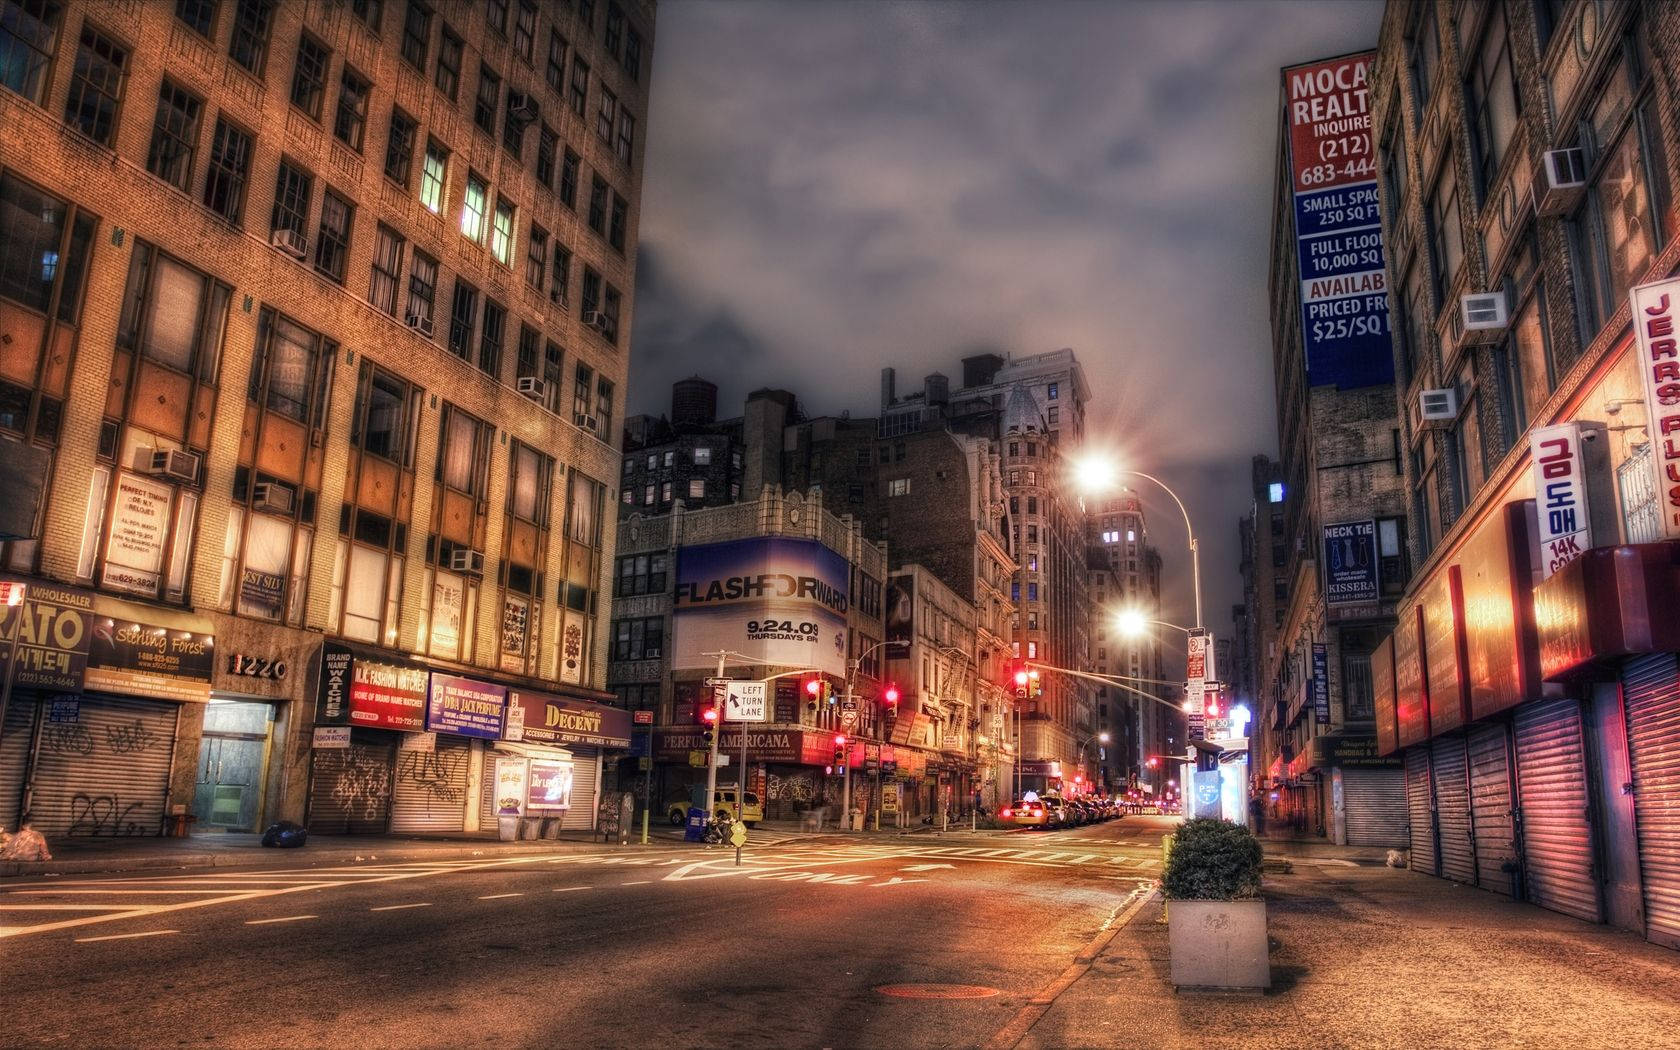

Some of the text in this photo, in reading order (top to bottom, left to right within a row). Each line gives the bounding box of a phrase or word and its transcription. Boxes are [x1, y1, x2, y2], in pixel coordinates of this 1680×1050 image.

[1294, 89, 1368, 125] REALT
[1314, 115, 1371, 137] INQUIRE
[1320, 134, 1370, 161] (212)
[1303, 194, 1346, 212] SMALL
[1320, 210, 1344, 226] 250
[1347, 206, 1364, 220] SQ
[1310, 240, 1342, 256] FULL
[1312, 250, 1378, 271] 10,000 SQ
[1310, 273, 1384, 299] AVAILAB
[1310, 299, 1360, 319] PRICED
[1313, 315, 1381, 342] $25/SQ
[120, 484, 168, 504] PERFECT TIMING
[1539, 437, 1576, 535] 금도매
[129, 504, 154, 516] RELOJES
[1325, 526, 1354, 538] NECK
[1550, 536, 1580, 558] 14K
[31, 587, 91, 608] WHOLESALER
[674, 574, 847, 613] FLASHFORWARD
[1329, 582, 1375, 593] KISSERA
[748, 620, 818, 636] 9.24.09
[116, 628, 205, 655] Sterling Forest
[231, 654, 287, 680] 1220
[18, 672, 38, 684] (212)
[370, 670, 396, 688] FASHION
[398, 672, 424, 692] WATCHES
[326, 670, 344, 717] WATCHES
[354, 691, 422, 708] HOME OF BRAND NAME WATCHES
[458, 688, 472, 698] BALANCE
[461, 698, 476, 712] JACK
[476, 701, 501, 716] PERFUME
[545, 704, 600, 732] DECENT
[526, 730, 554, 739] ACCESSORIES
[561, 734, 580, 742] JEWELRY
[586, 736, 604, 745] WATCHES
[664, 735, 708, 748] PERFUM
[719, 734, 790, 748] AMERICANA
